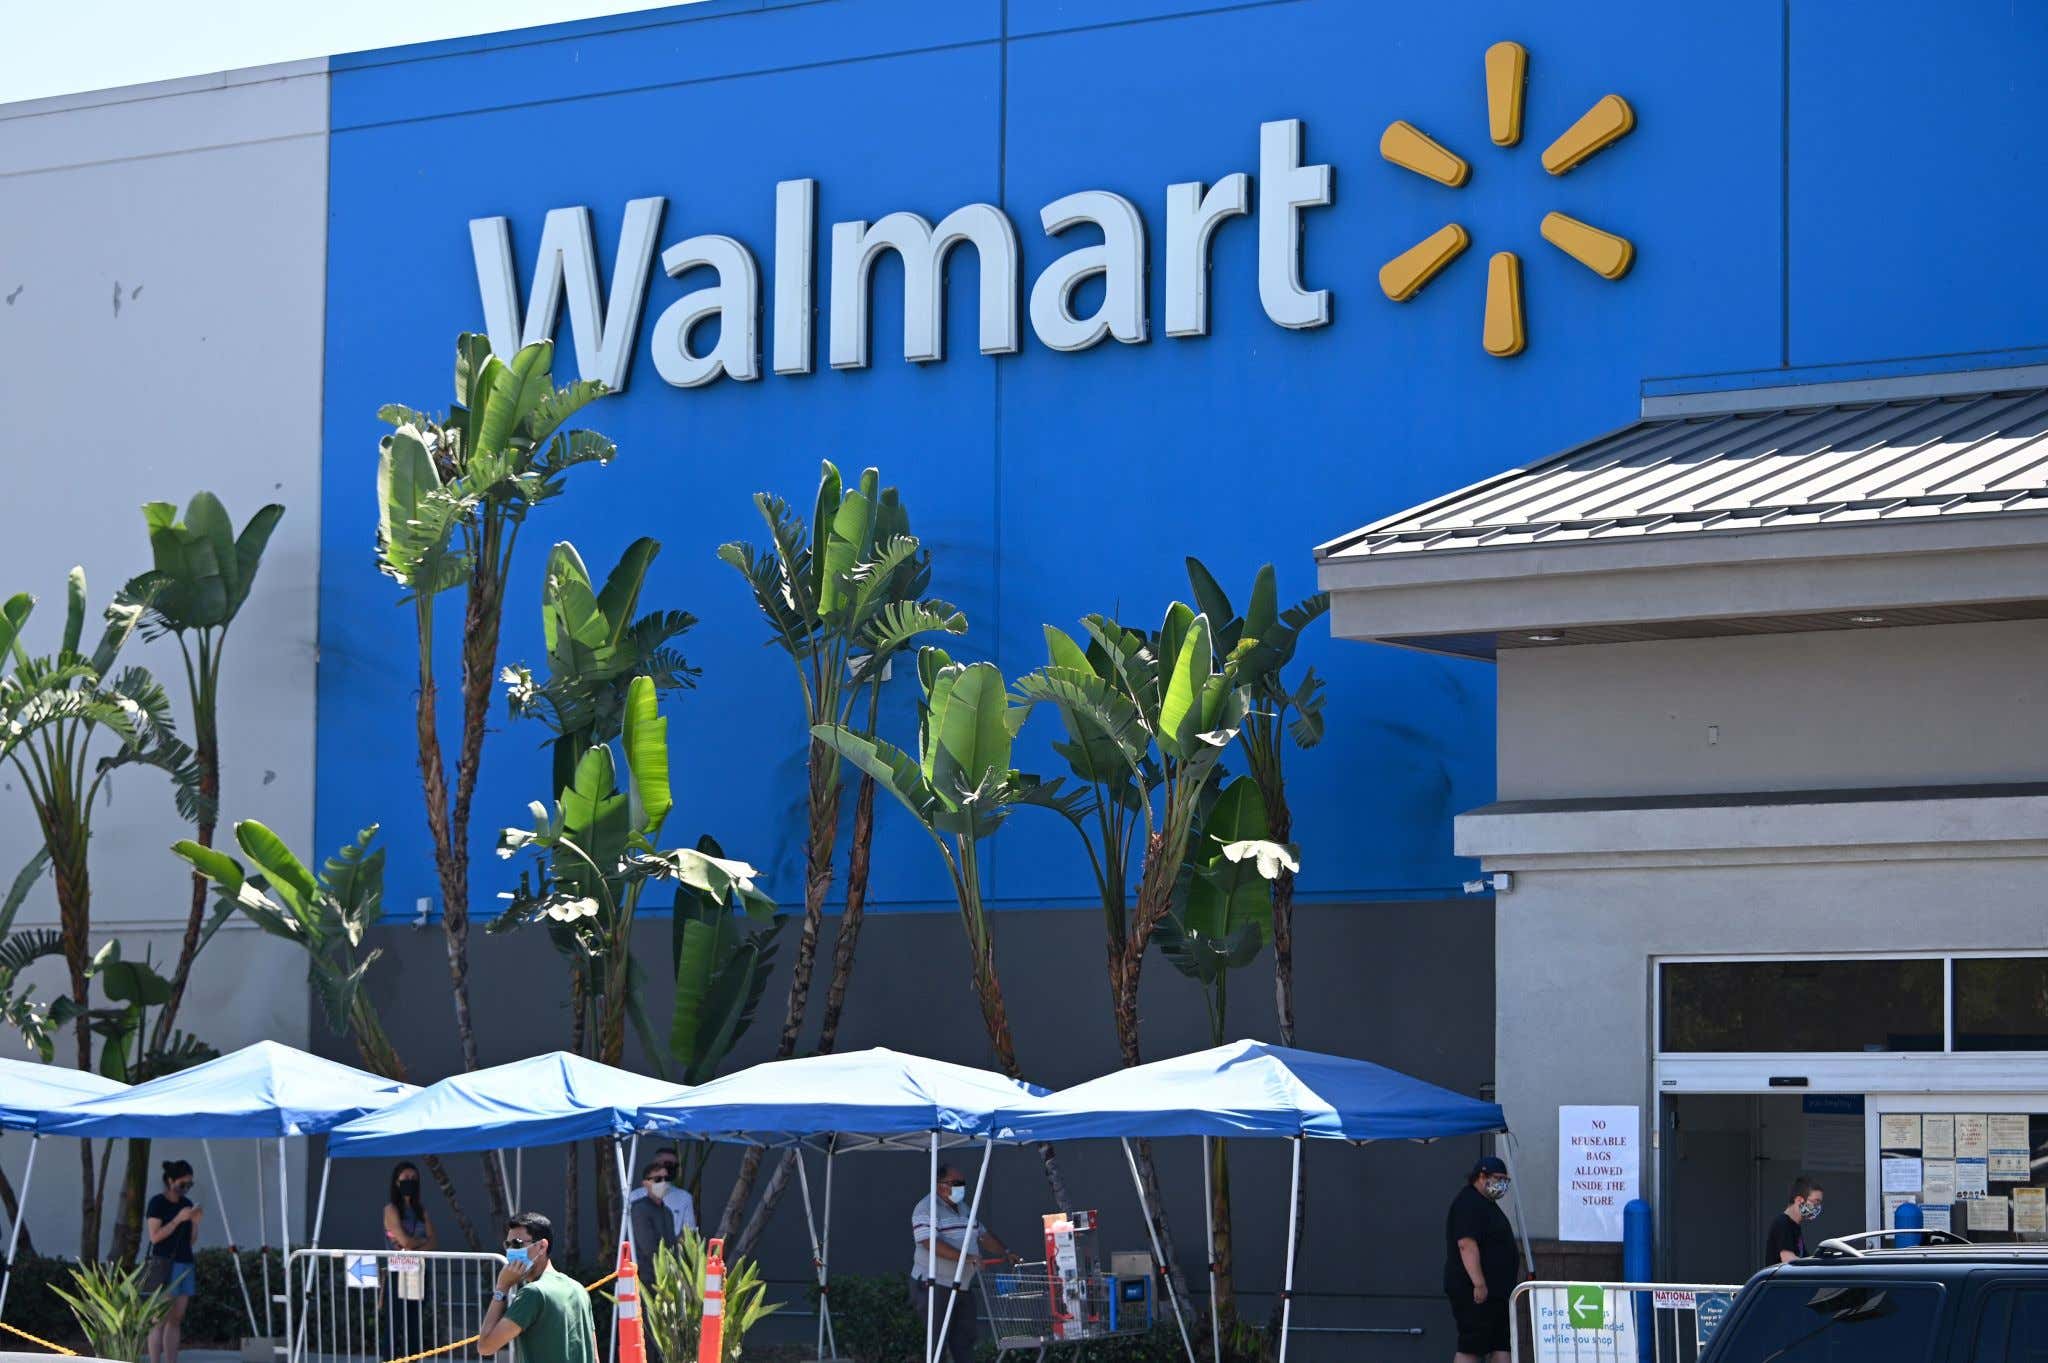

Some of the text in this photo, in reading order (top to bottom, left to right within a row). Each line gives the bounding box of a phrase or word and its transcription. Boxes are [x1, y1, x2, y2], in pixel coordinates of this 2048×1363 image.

[468, 117, 1331, 393] Walmart
[1592, 1120, 1606, 1129] NO
[1571, 1136, 1627, 1146] REUSEABLE
[1586, 1151, 1612, 1161] BAGS
[1575, 1166, 1623, 1176] ALLOWED
[1572, 1181, 1626, 1191] INSIDE THE
[1582, 1196, 1614, 1206] STORE
[1655, 1291, 1695, 1301] NATIONAL
